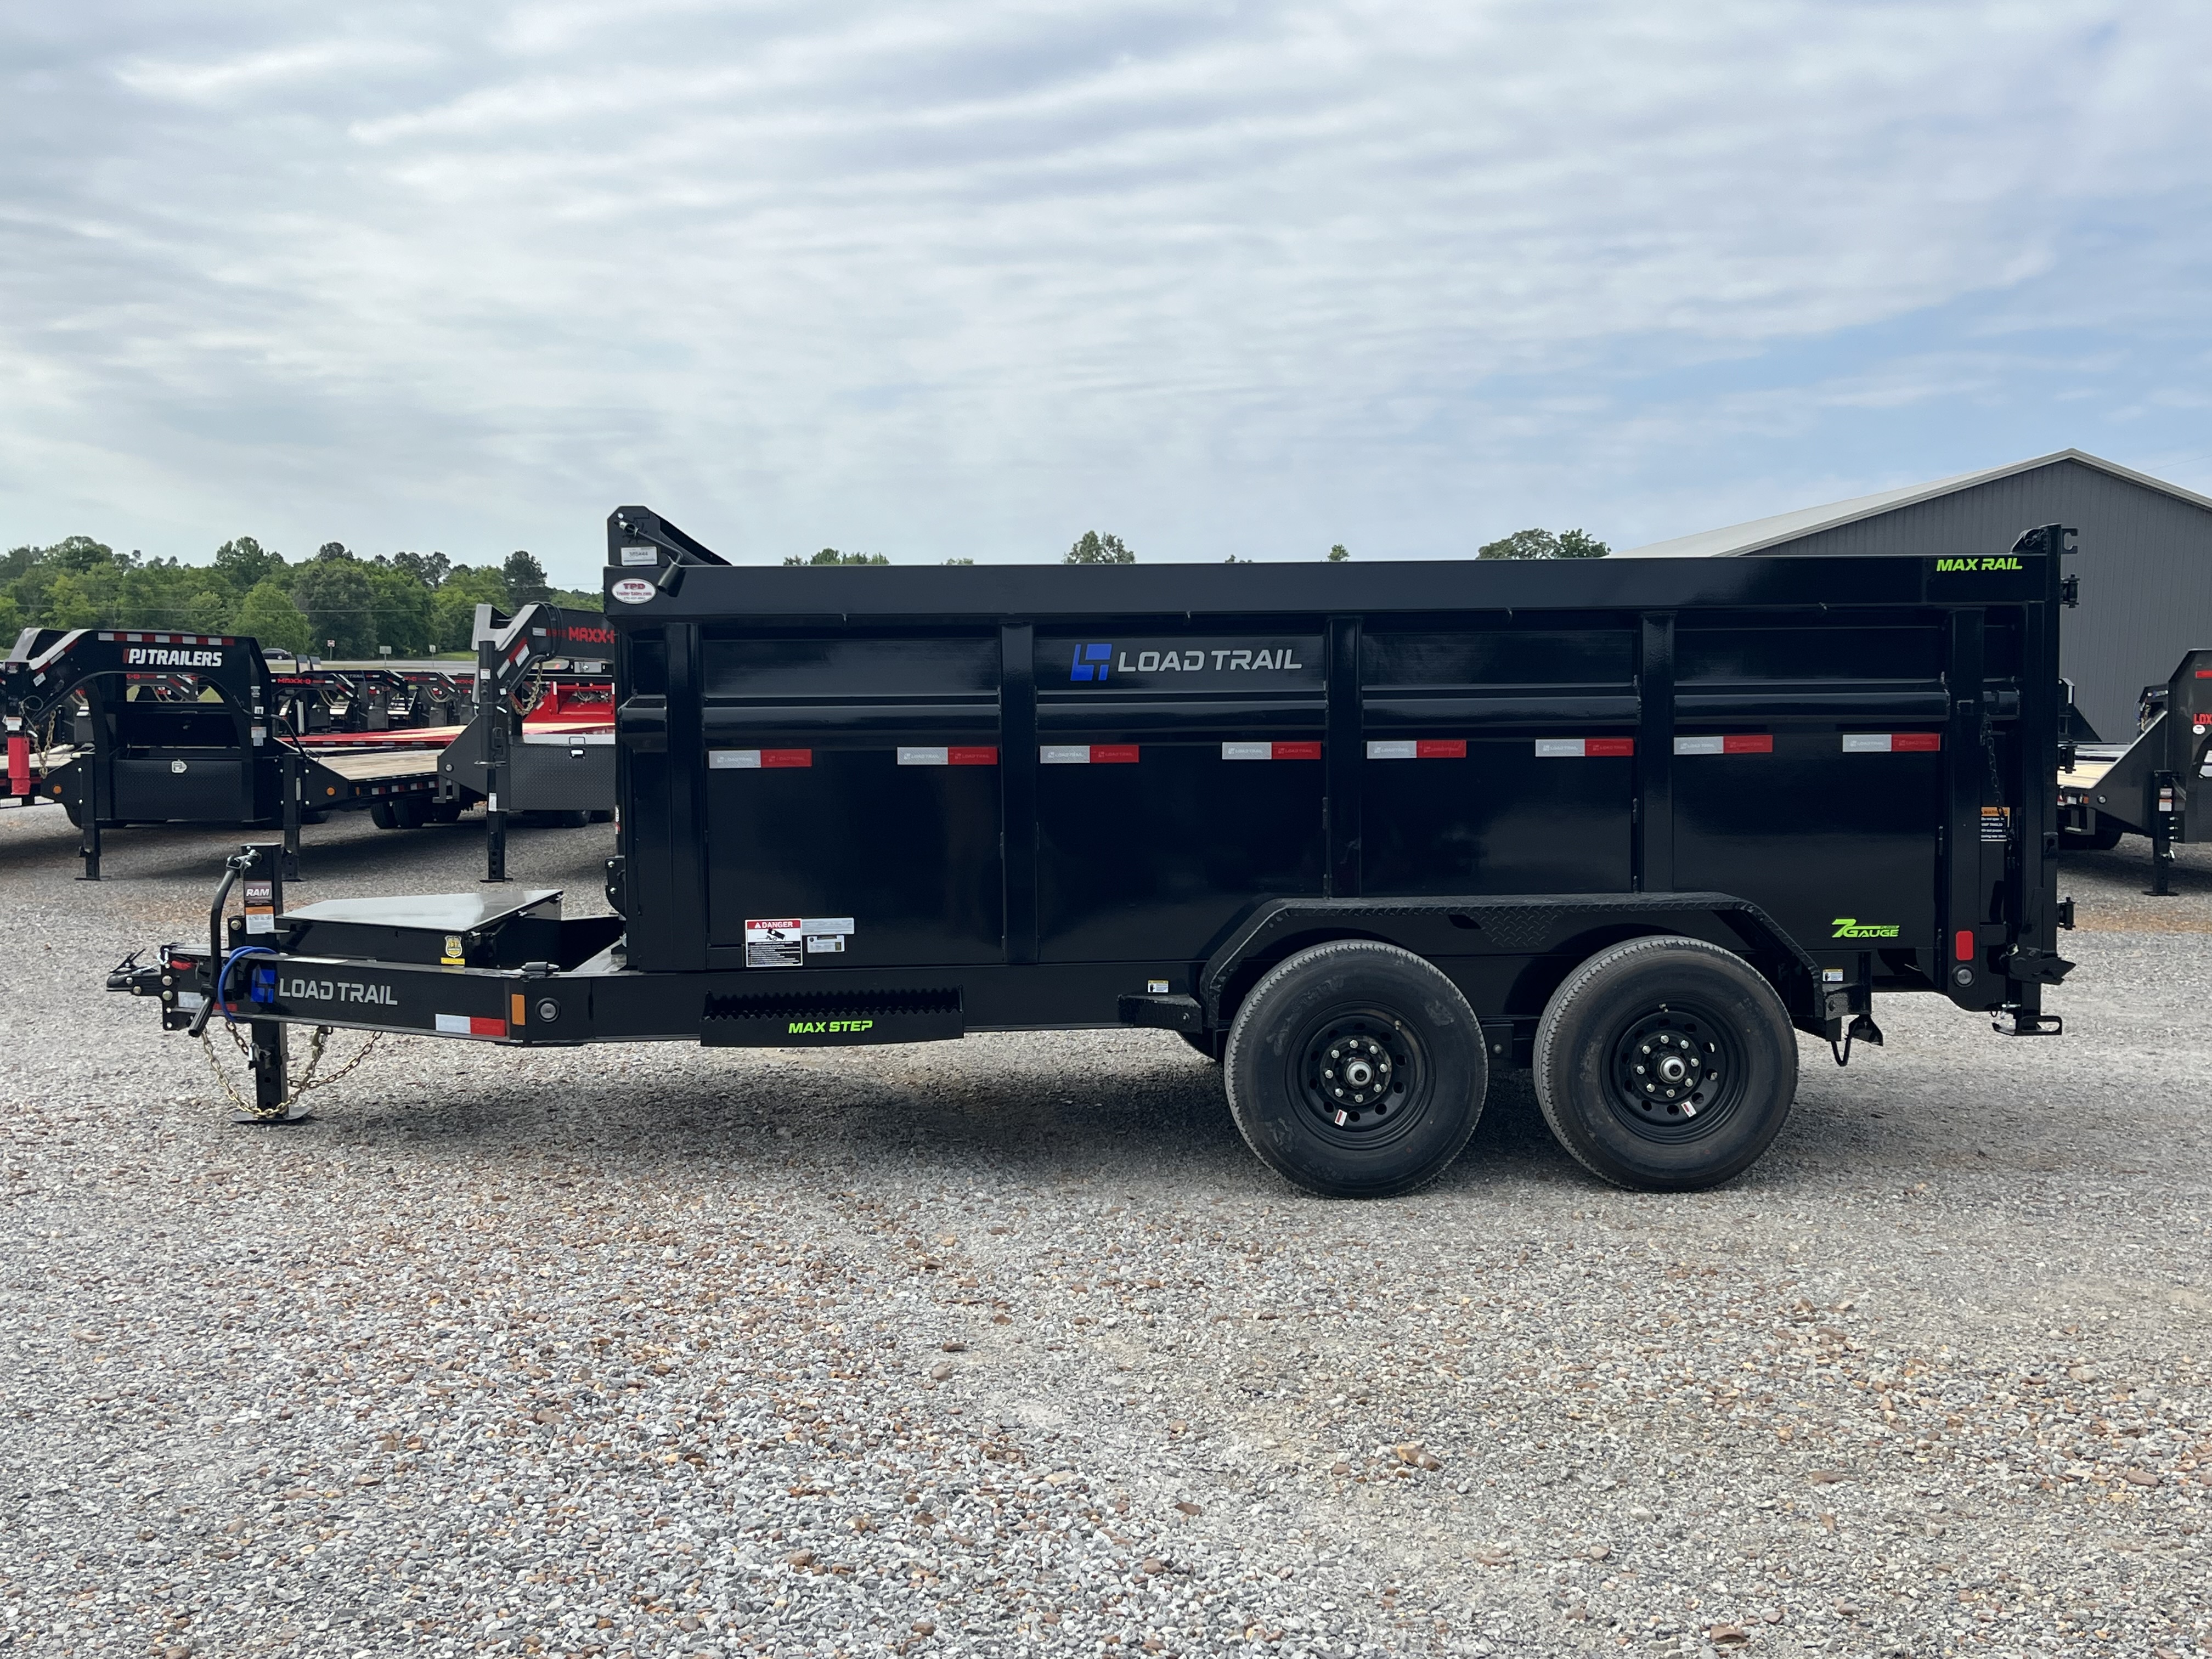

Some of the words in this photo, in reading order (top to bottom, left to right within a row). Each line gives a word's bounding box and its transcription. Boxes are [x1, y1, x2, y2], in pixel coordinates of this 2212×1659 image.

[1936, 558, 1979, 571] MAX
[1981, 557, 2023, 570] RAIL
[128, 648, 146, 664] PJ
[147, 649, 222, 667] TRAILERS
[1118, 651, 1204, 672] LOAD
[1211, 650, 1302, 670] TRAIL
[1832, 918, 1857, 938] 7
[1843, 926, 1899, 938] GAUGE
[279, 978, 334, 1000] LOAD
[337, 982, 398, 1005] TRAIL
[788, 1022, 827, 1034] MAX
[829, 1020, 873, 1032] STEP
